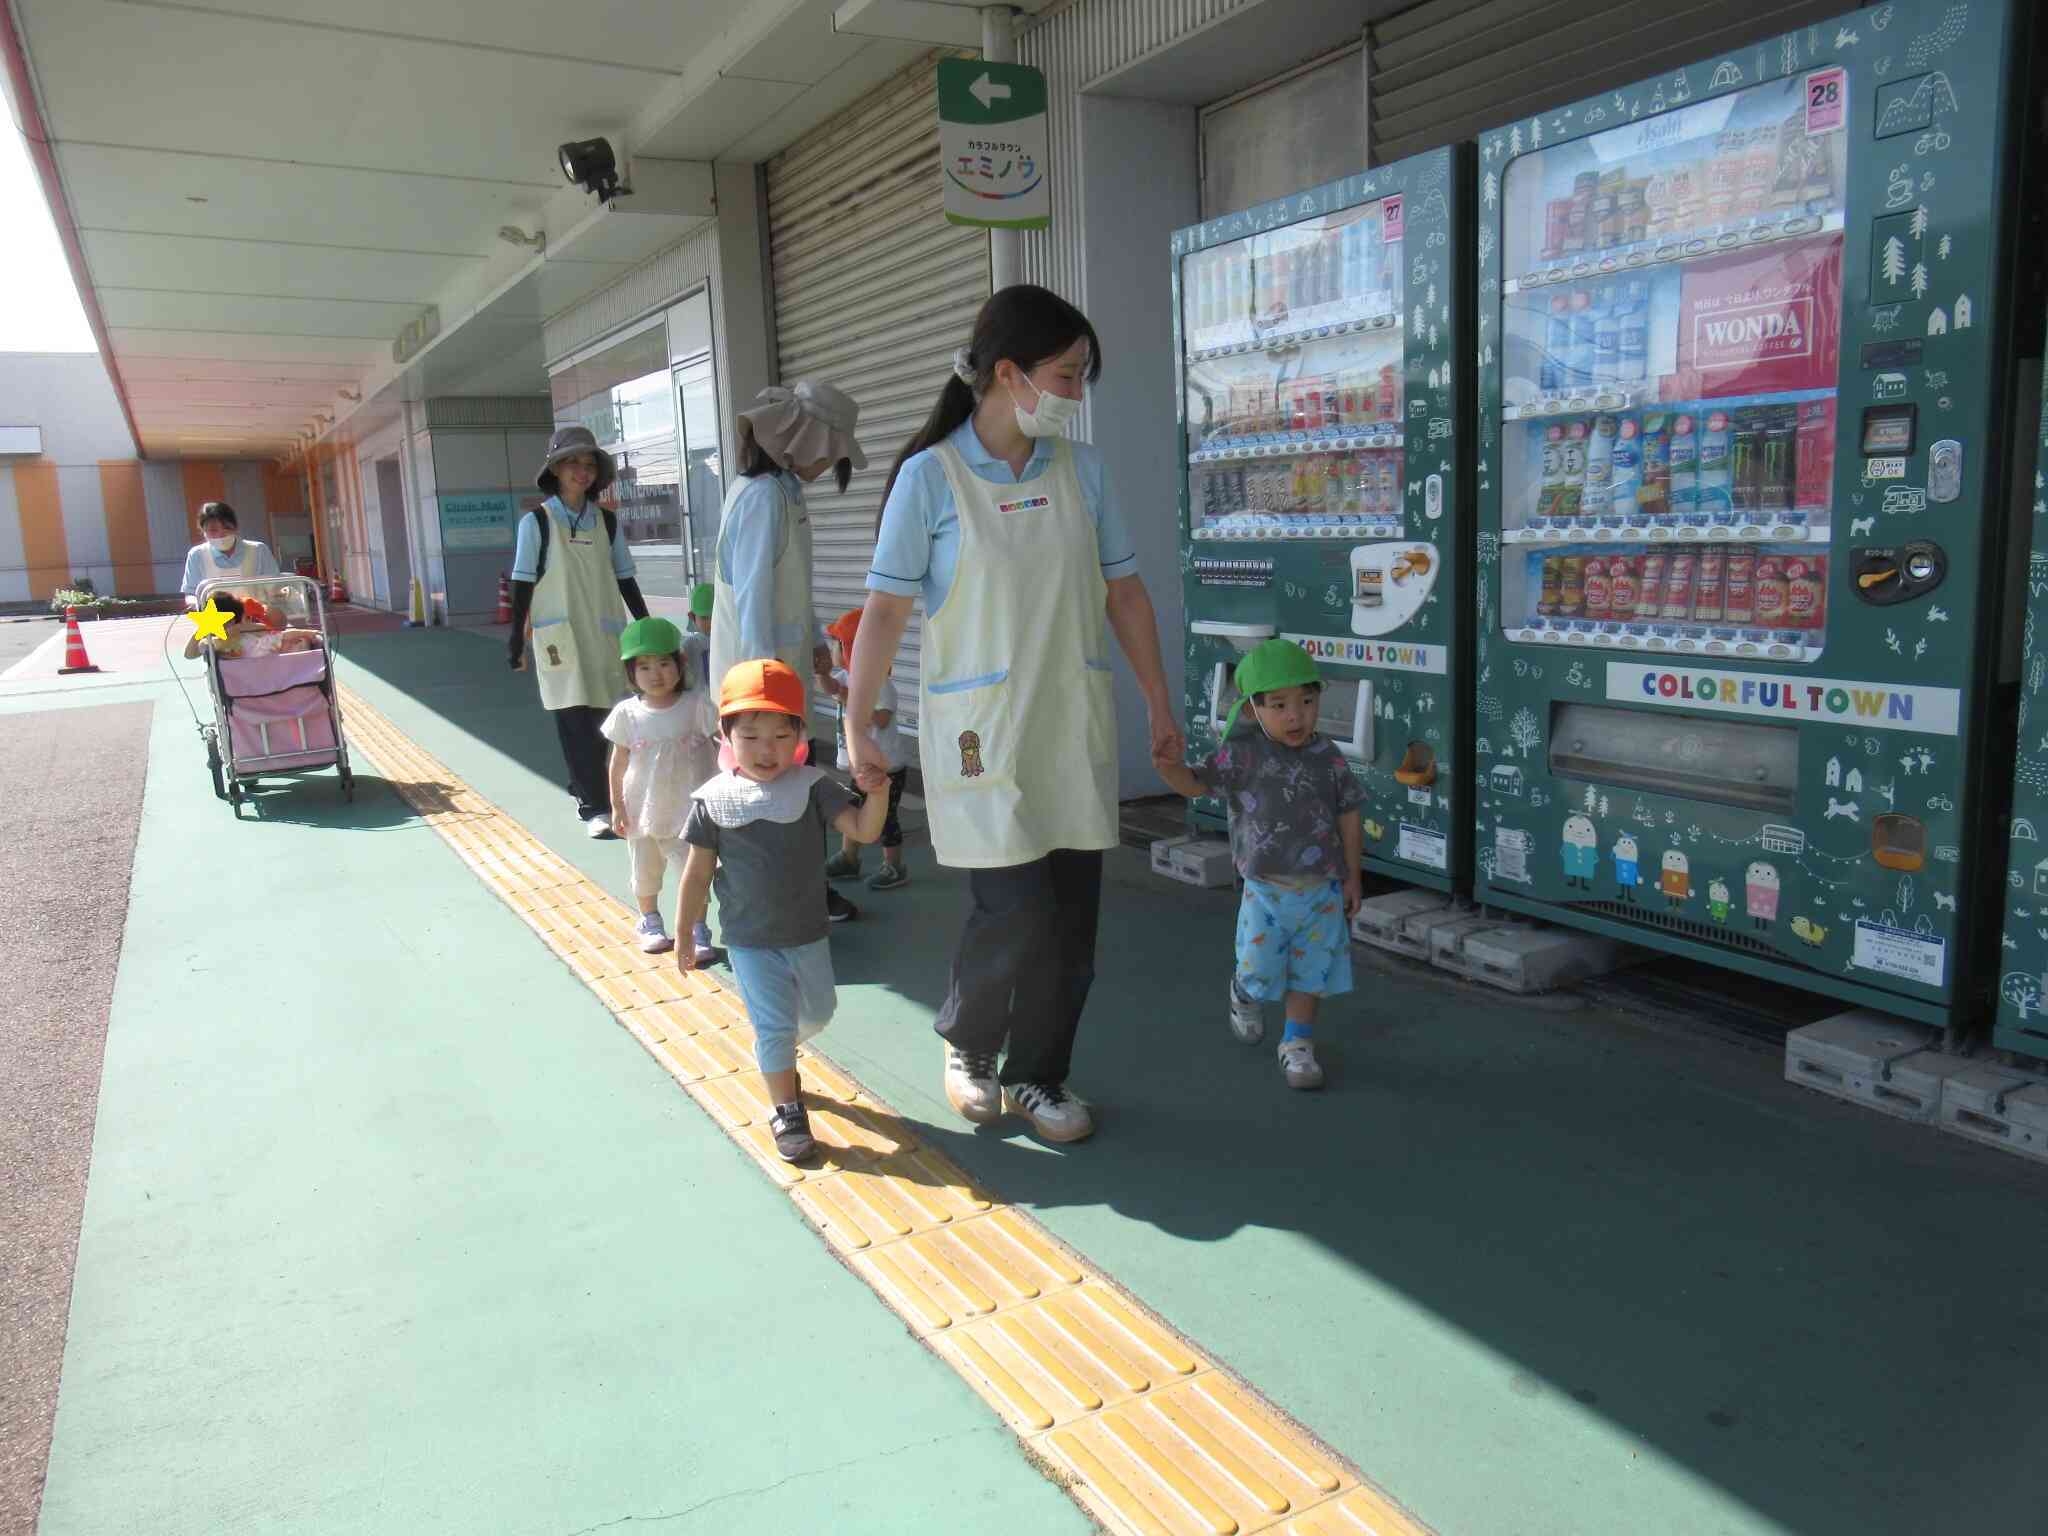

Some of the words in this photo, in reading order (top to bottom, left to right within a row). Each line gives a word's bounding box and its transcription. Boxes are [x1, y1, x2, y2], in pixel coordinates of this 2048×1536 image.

[1812, 81, 1838, 107] 28
[1386, 203, 1401, 222] 27
[1704, 310, 1801, 346] WONDA
[1377, 645, 1427, 667] TOWN
[1642, 671, 1797, 709] COLORFUL
[1807, 686, 1914, 720] TOWN
